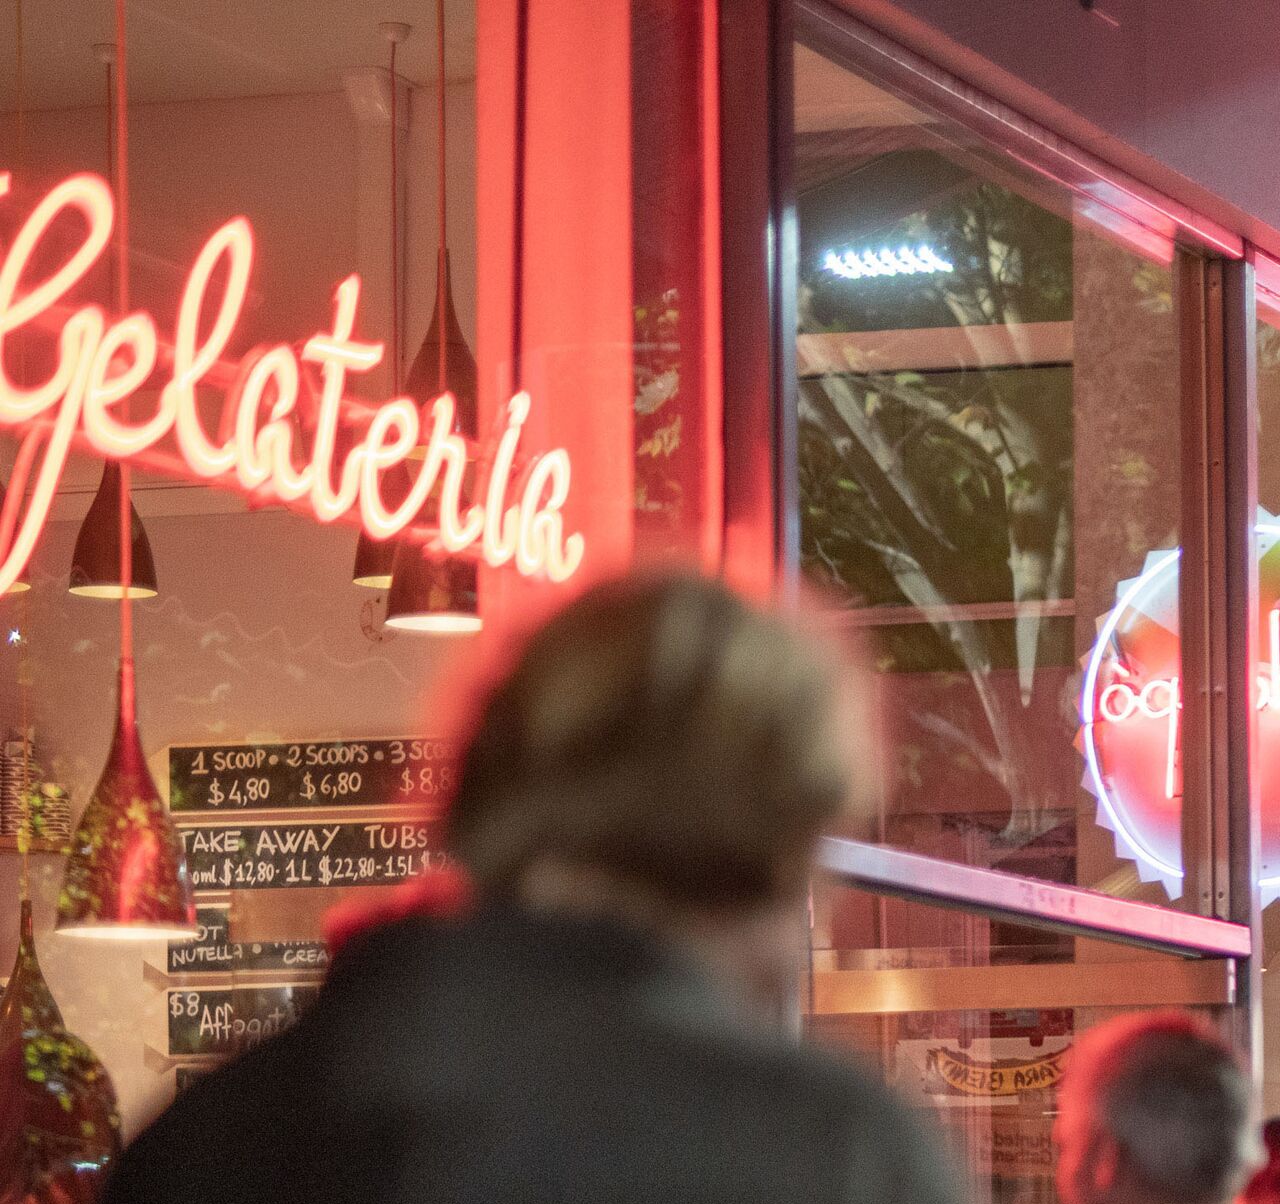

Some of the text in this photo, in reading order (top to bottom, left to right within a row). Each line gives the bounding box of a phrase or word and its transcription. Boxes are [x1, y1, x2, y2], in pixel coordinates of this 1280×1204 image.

[191, 751, 209, 775] 1
[213, 749, 266, 771] SCOOP
[286, 745, 301, 768] 2
[306, 745, 369, 766] SCOOPS
[389, 741, 406, 764] 3
[178, 830, 242, 853] TAKE
[256, 825, 340, 856] AWAY
[172, 943, 243, 967] NUTELLA
[170, 992, 200, 1018] $8
